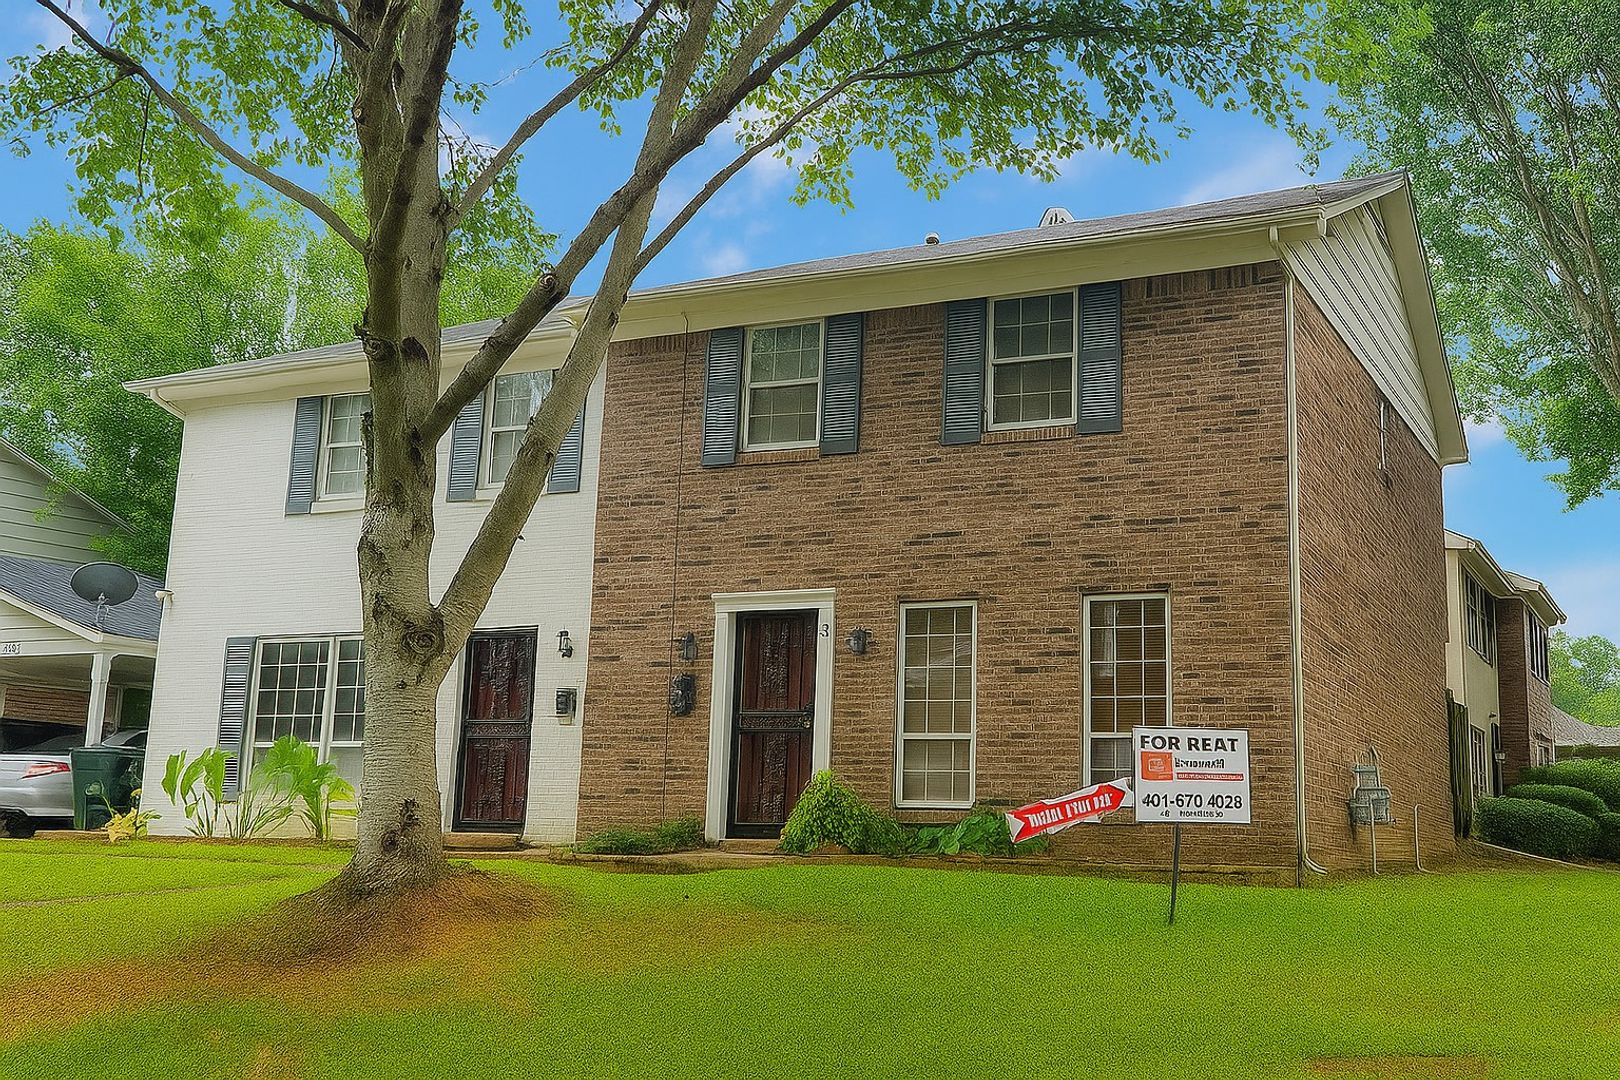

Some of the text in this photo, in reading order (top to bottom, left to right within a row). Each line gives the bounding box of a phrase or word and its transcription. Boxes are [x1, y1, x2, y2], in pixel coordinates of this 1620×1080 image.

[819, 623, 829, 637] 3
[1140, 735, 1181, 751] FOR
[1142, 793, 1243, 809] 401-670 4028
